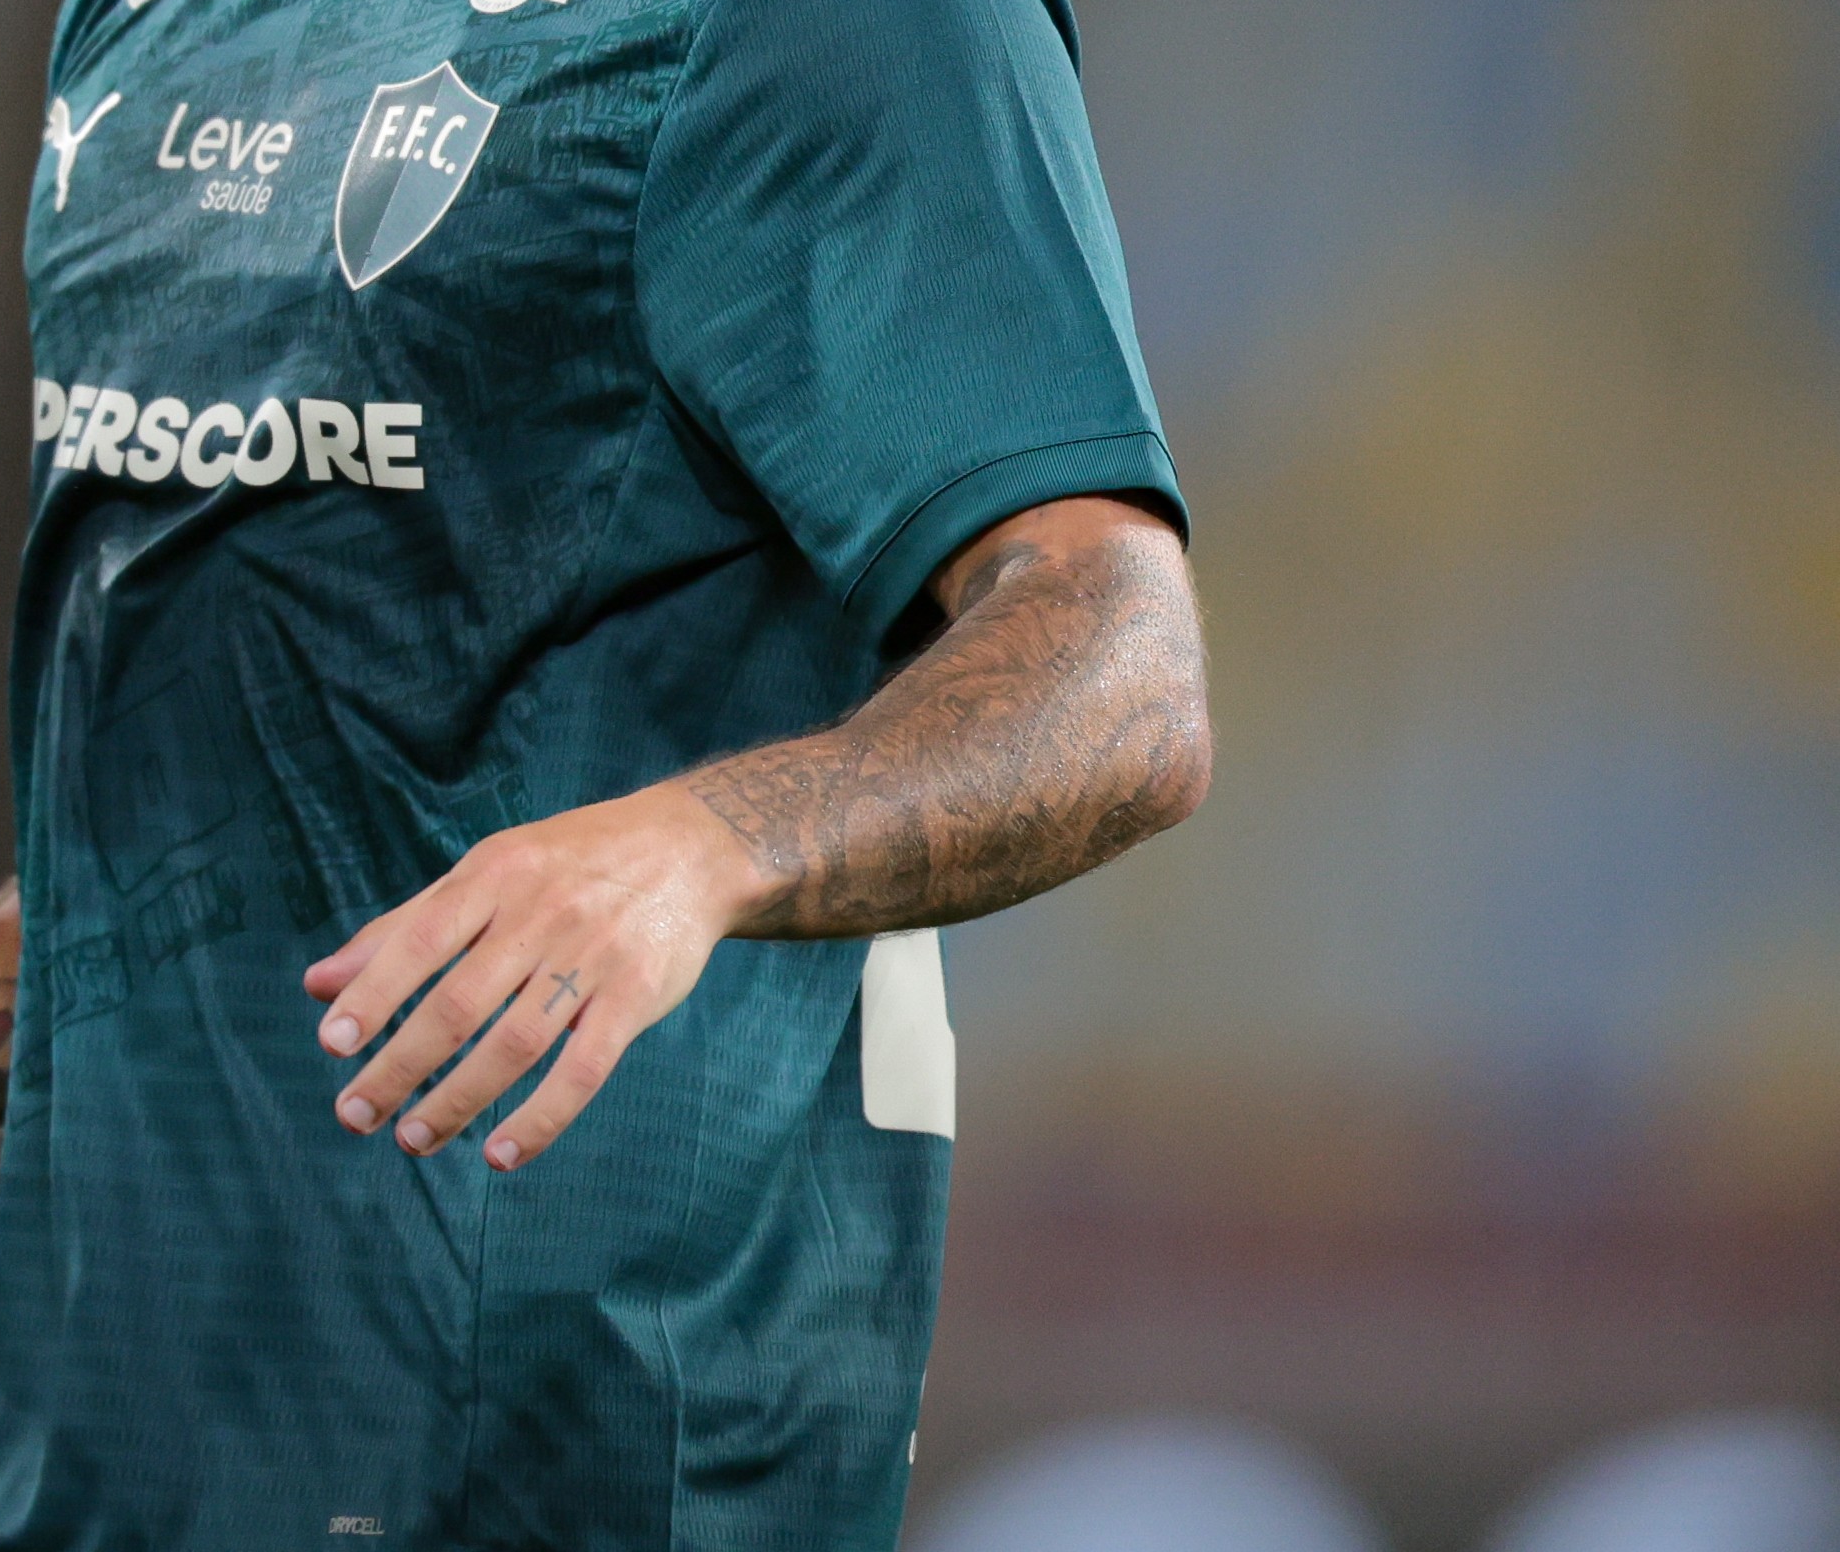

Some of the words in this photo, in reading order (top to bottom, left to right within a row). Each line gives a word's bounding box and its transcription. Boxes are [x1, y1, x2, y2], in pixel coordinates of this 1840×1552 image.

[157, 102, 293, 175] Leve
[369, 104, 467, 175] F.F.C.
[199, 174, 273, 215] saúde
[33, 377, 425, 490] PERSCORE
